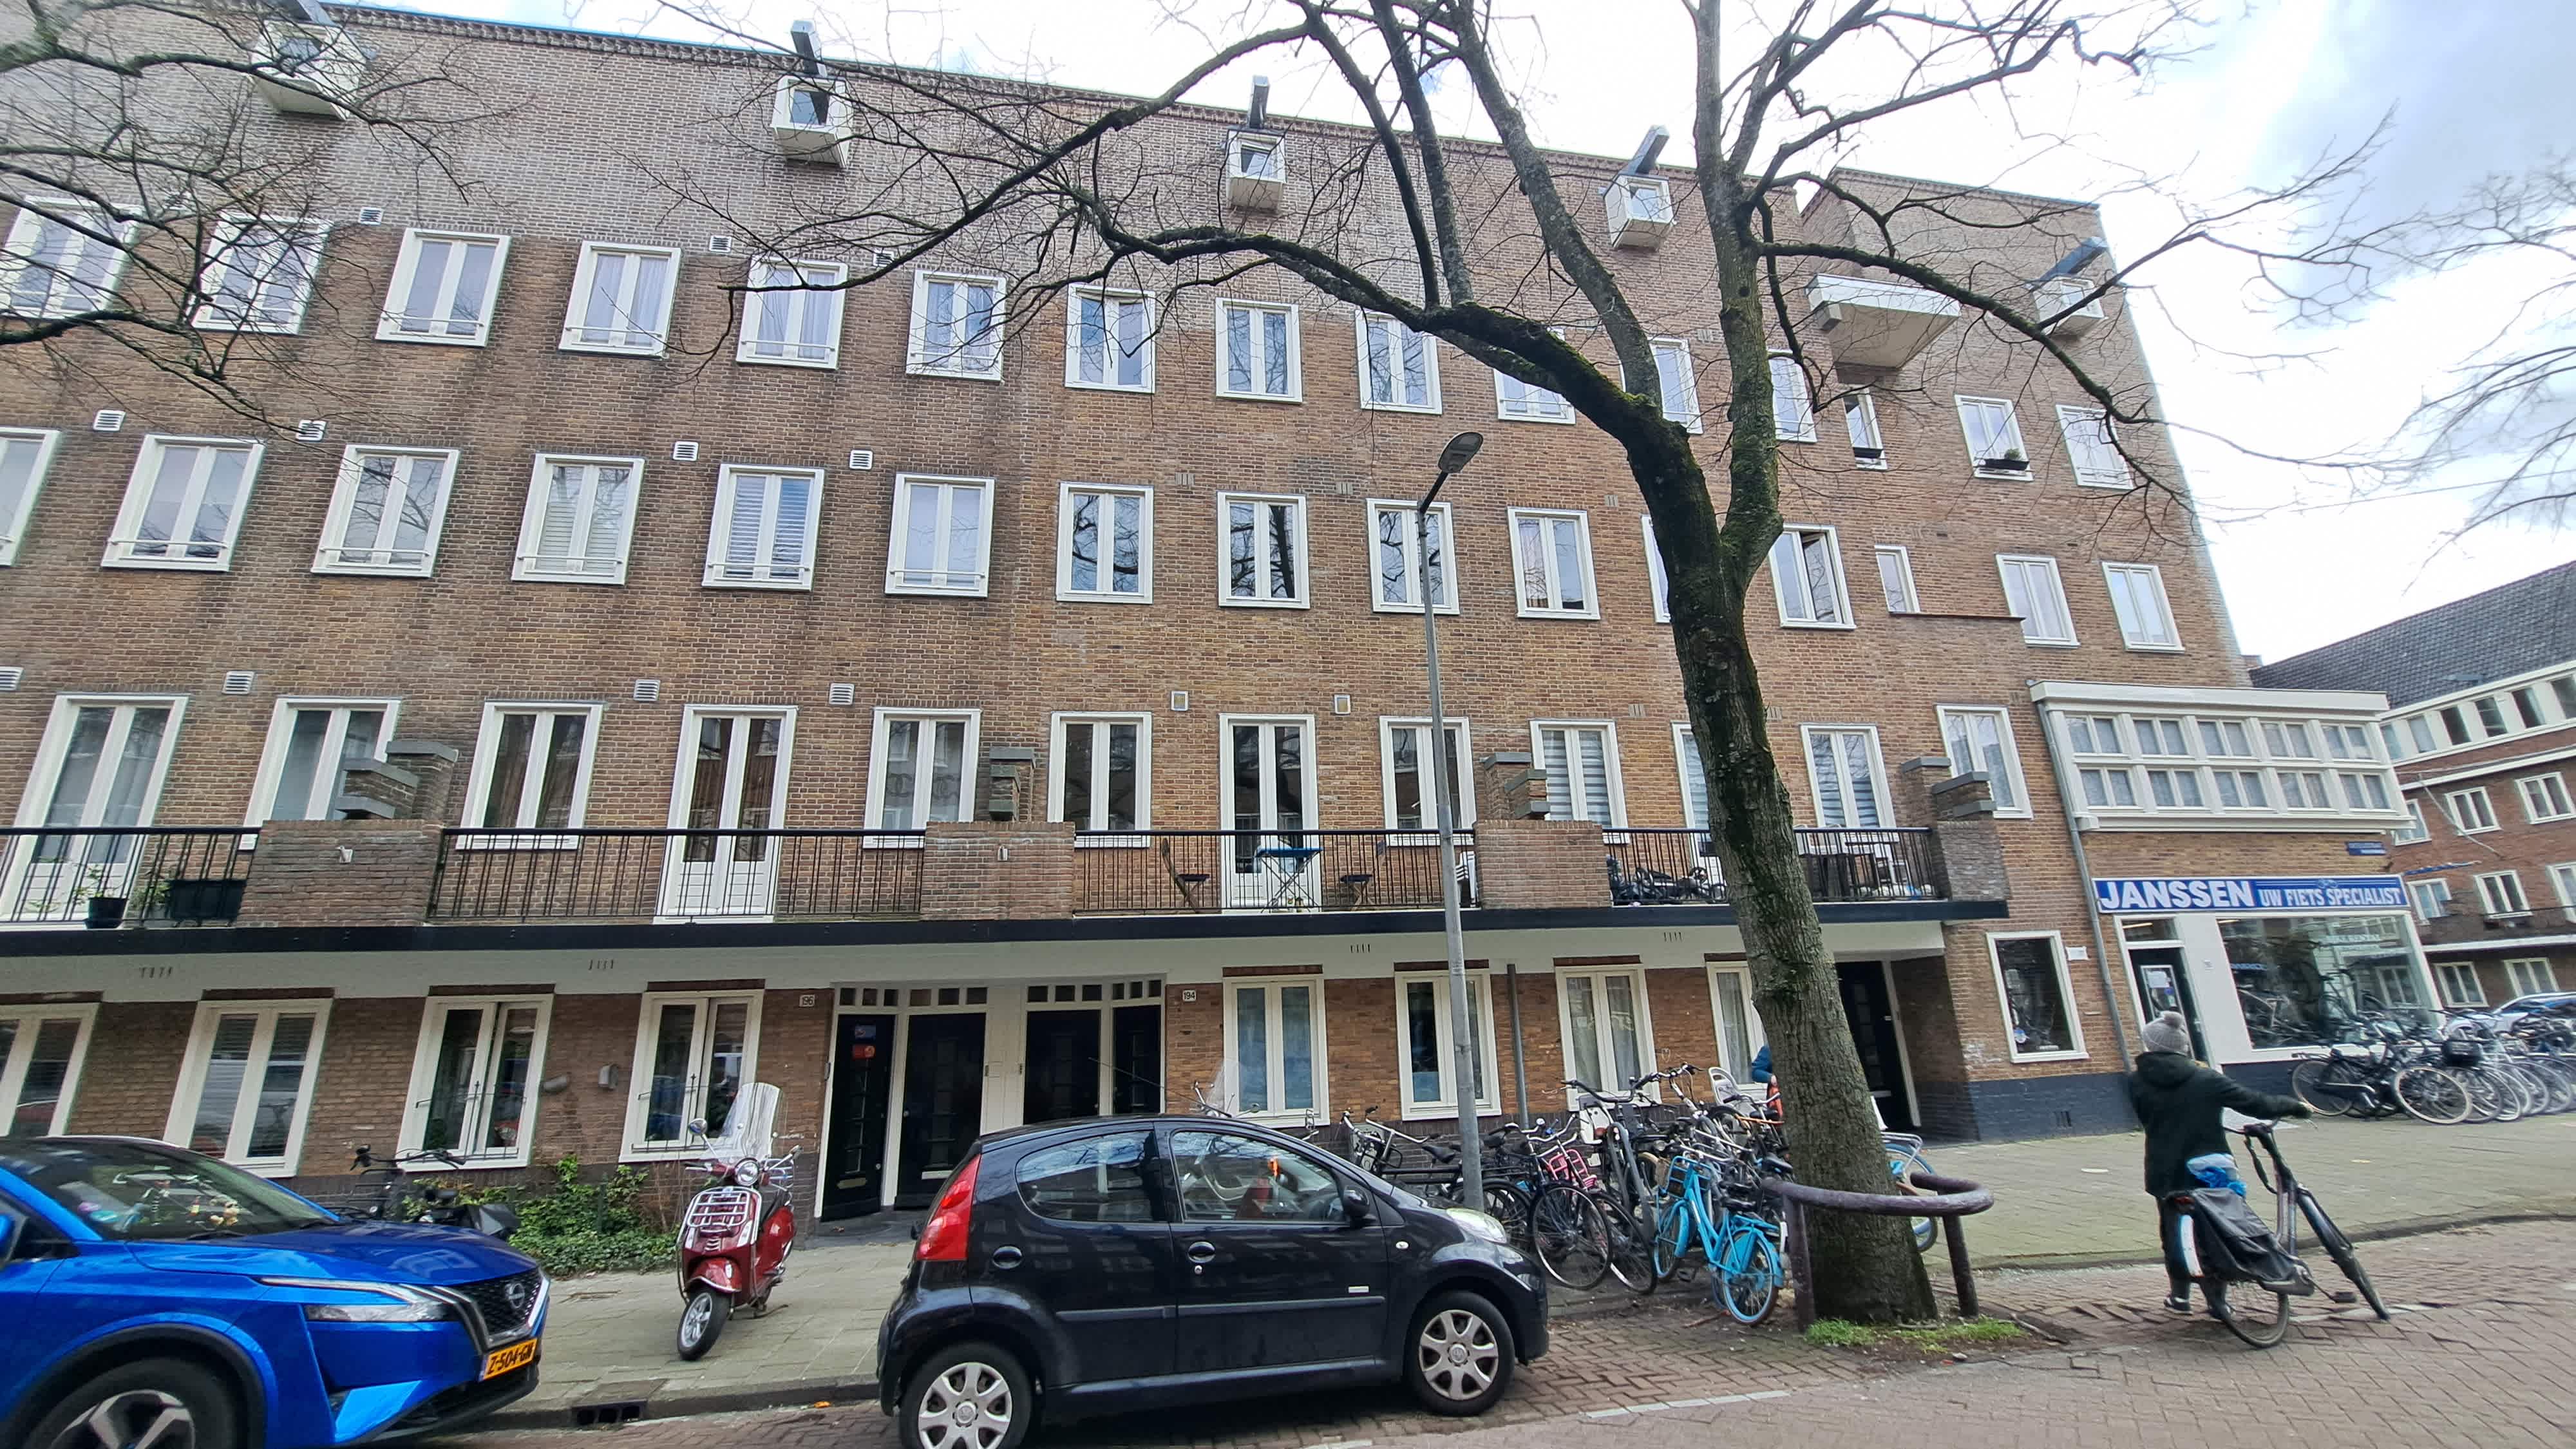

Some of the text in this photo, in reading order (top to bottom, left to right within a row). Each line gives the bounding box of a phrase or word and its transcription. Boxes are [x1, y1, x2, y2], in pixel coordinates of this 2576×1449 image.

[2099, 880, 2401, 909] JANSSEN UW FIETS SPECIALIST
[1184, 991, 1195, 1000] 194
[801, 996, 814, 1005] 196
